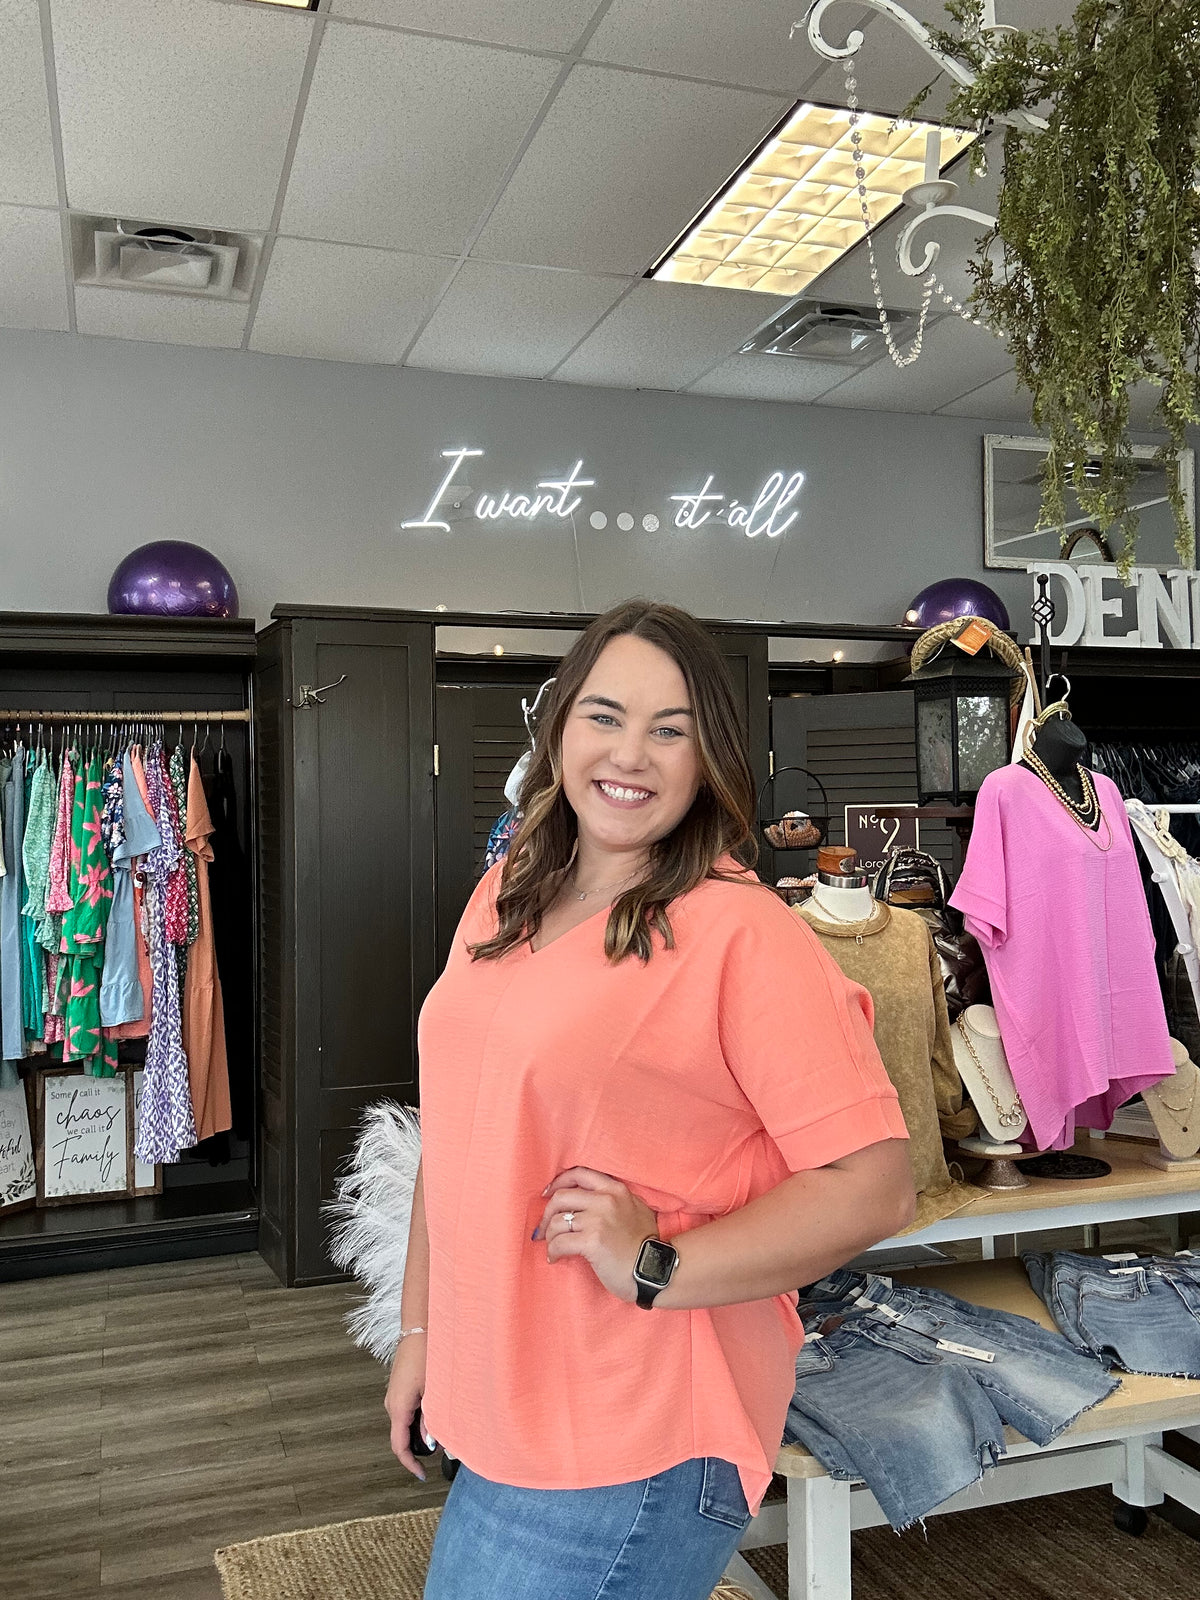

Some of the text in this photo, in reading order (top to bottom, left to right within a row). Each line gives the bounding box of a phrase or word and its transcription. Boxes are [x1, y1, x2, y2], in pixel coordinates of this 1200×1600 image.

[400, 447, 484, 533] I
[474, 459, 596, 520] want
[668, 474, 724, 530] it
[727, 471, 805, 539] all
[860, 858, 889, 868] Lora
[50, 1088, 101, 1100] Some call it
[56, 1088, 121, 1131] chaos
[66, 1125, 105, 1136] we call it
[51, 1134, 120, 1183] Family
